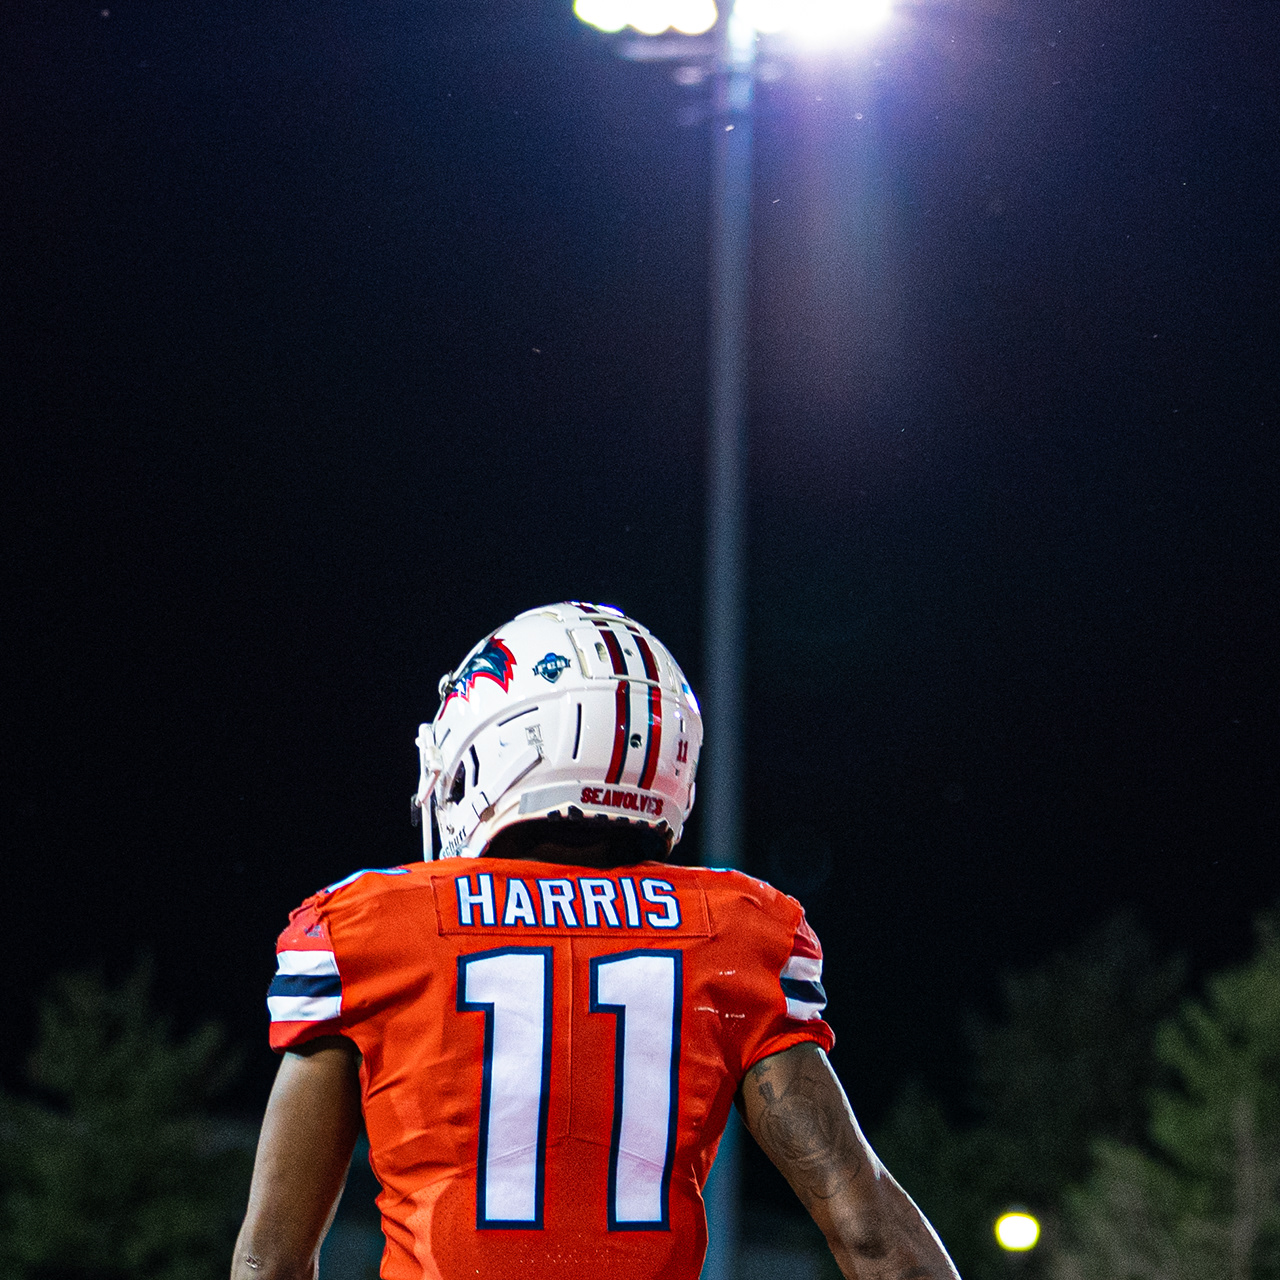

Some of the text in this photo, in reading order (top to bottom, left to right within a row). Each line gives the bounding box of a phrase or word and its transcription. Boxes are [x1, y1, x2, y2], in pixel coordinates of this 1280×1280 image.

[580, 785, 664, 817] SEAWOLVES
[455, 872, 683, 931] HARRIS
[456, 945, 684, 1232] 11
